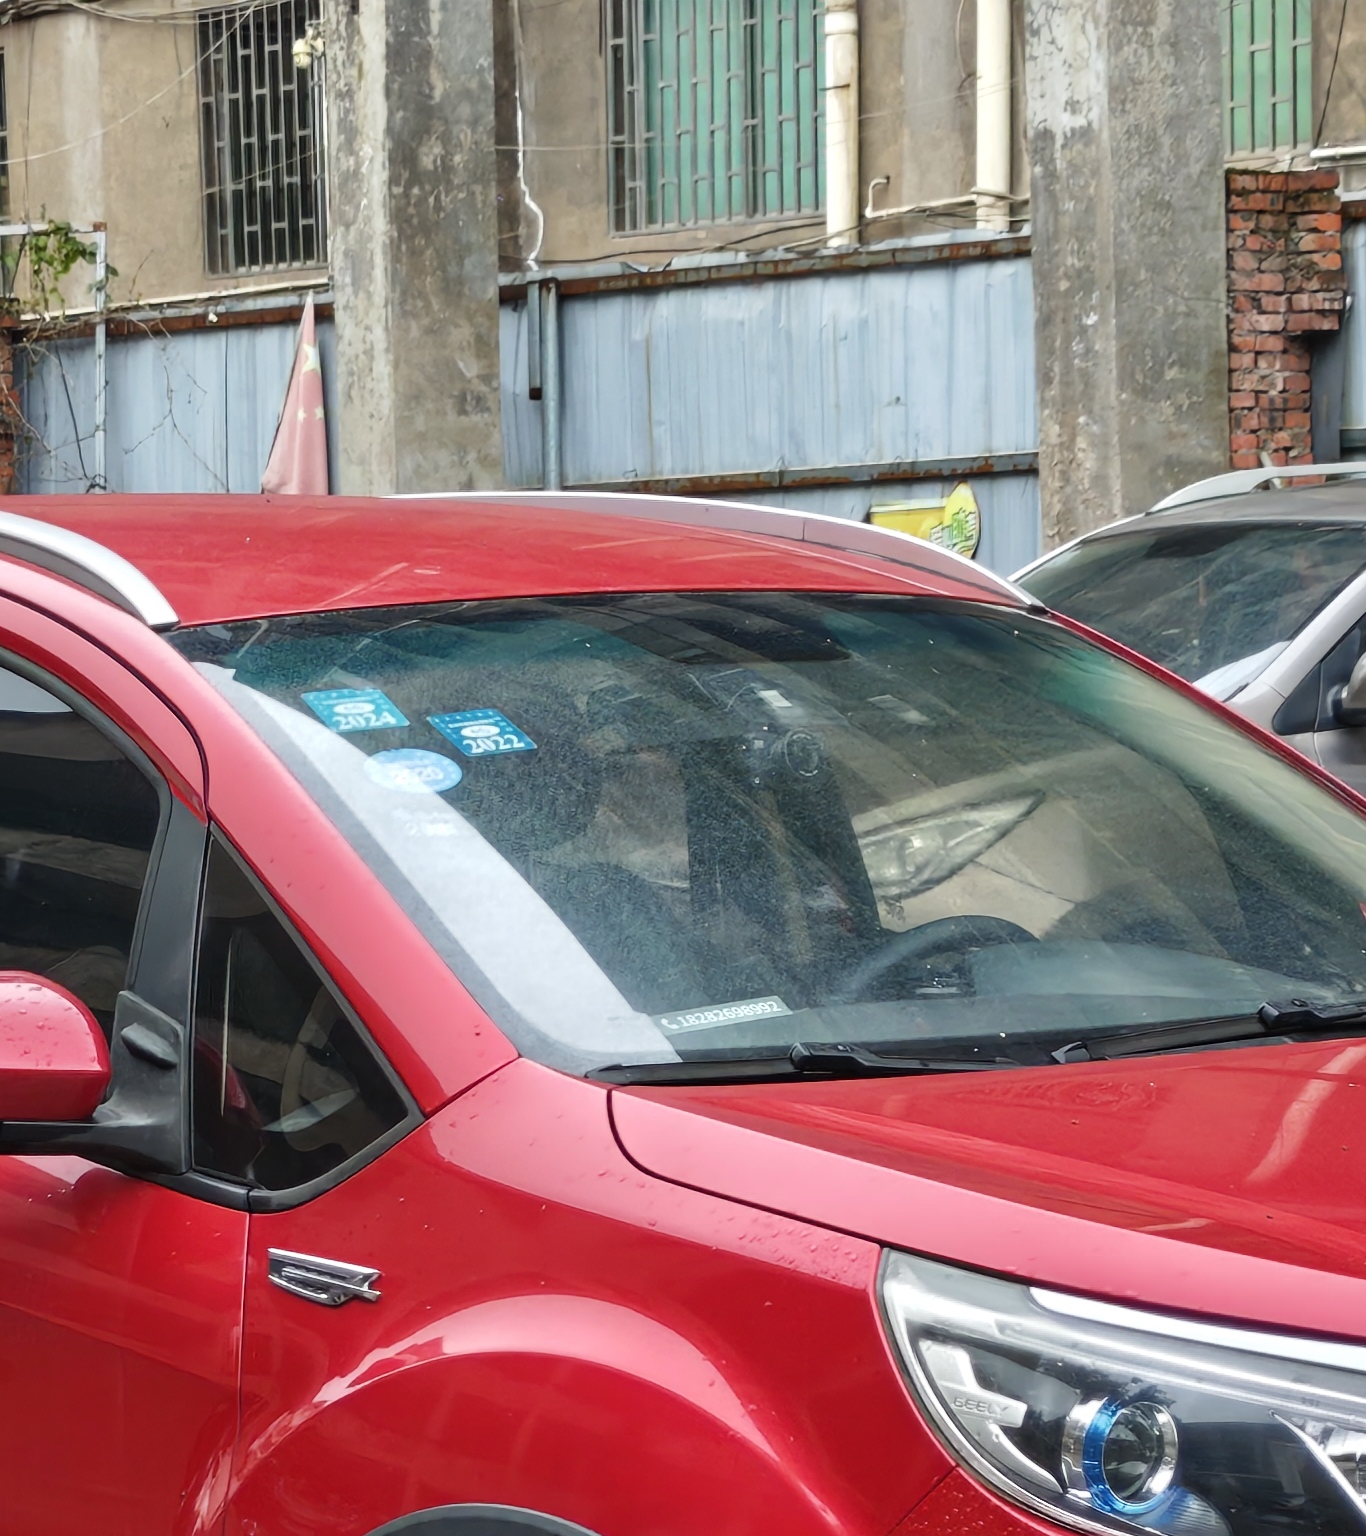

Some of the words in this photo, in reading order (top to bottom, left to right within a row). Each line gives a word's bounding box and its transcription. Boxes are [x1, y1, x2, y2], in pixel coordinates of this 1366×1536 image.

[332, 711, 397, 731] 2024
[463, 734, 526, 755] 2022
[677, 1001, 783, 1028] 18282698992
